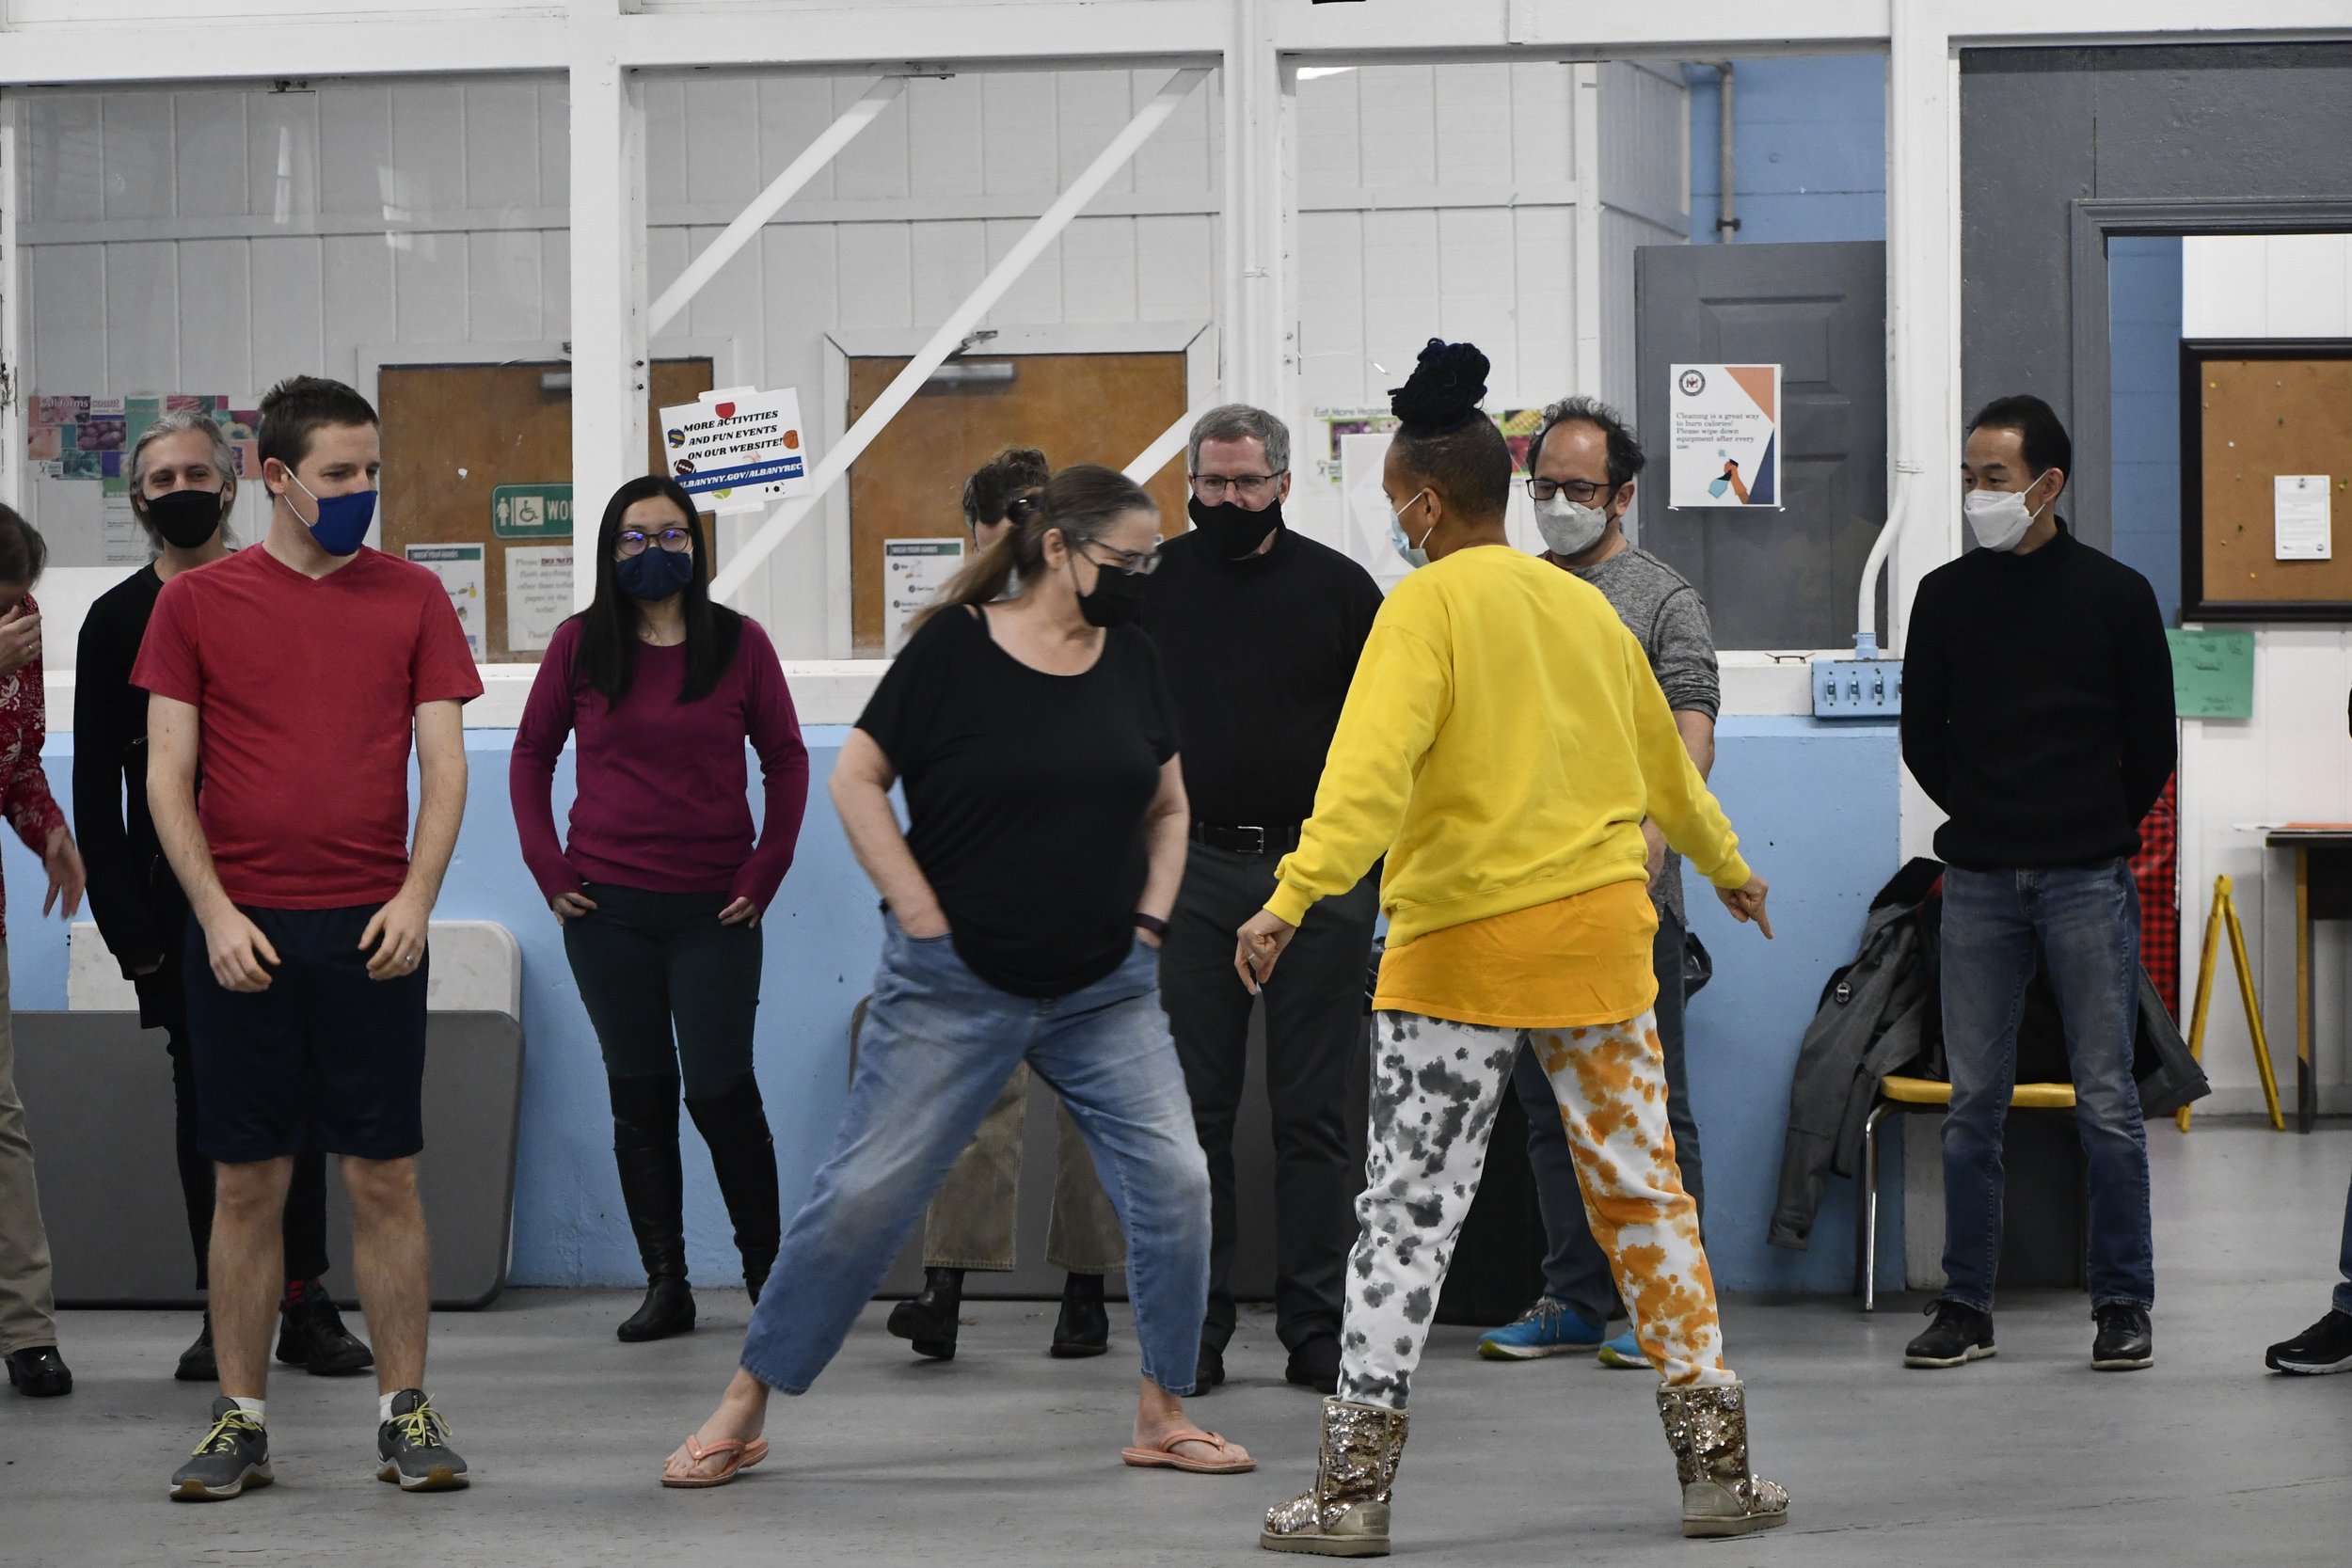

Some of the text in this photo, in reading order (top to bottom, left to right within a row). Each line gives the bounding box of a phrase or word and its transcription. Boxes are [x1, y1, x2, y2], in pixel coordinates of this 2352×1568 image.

[683, 410, 779, 433] MORE ACTIVITIES
[1676, 412, 1708, 420] Cleaning
[689, 424, 778, 446] AND FUN EVENTS
[688, 437, 783, 460] ON OUR WEBSITE!
